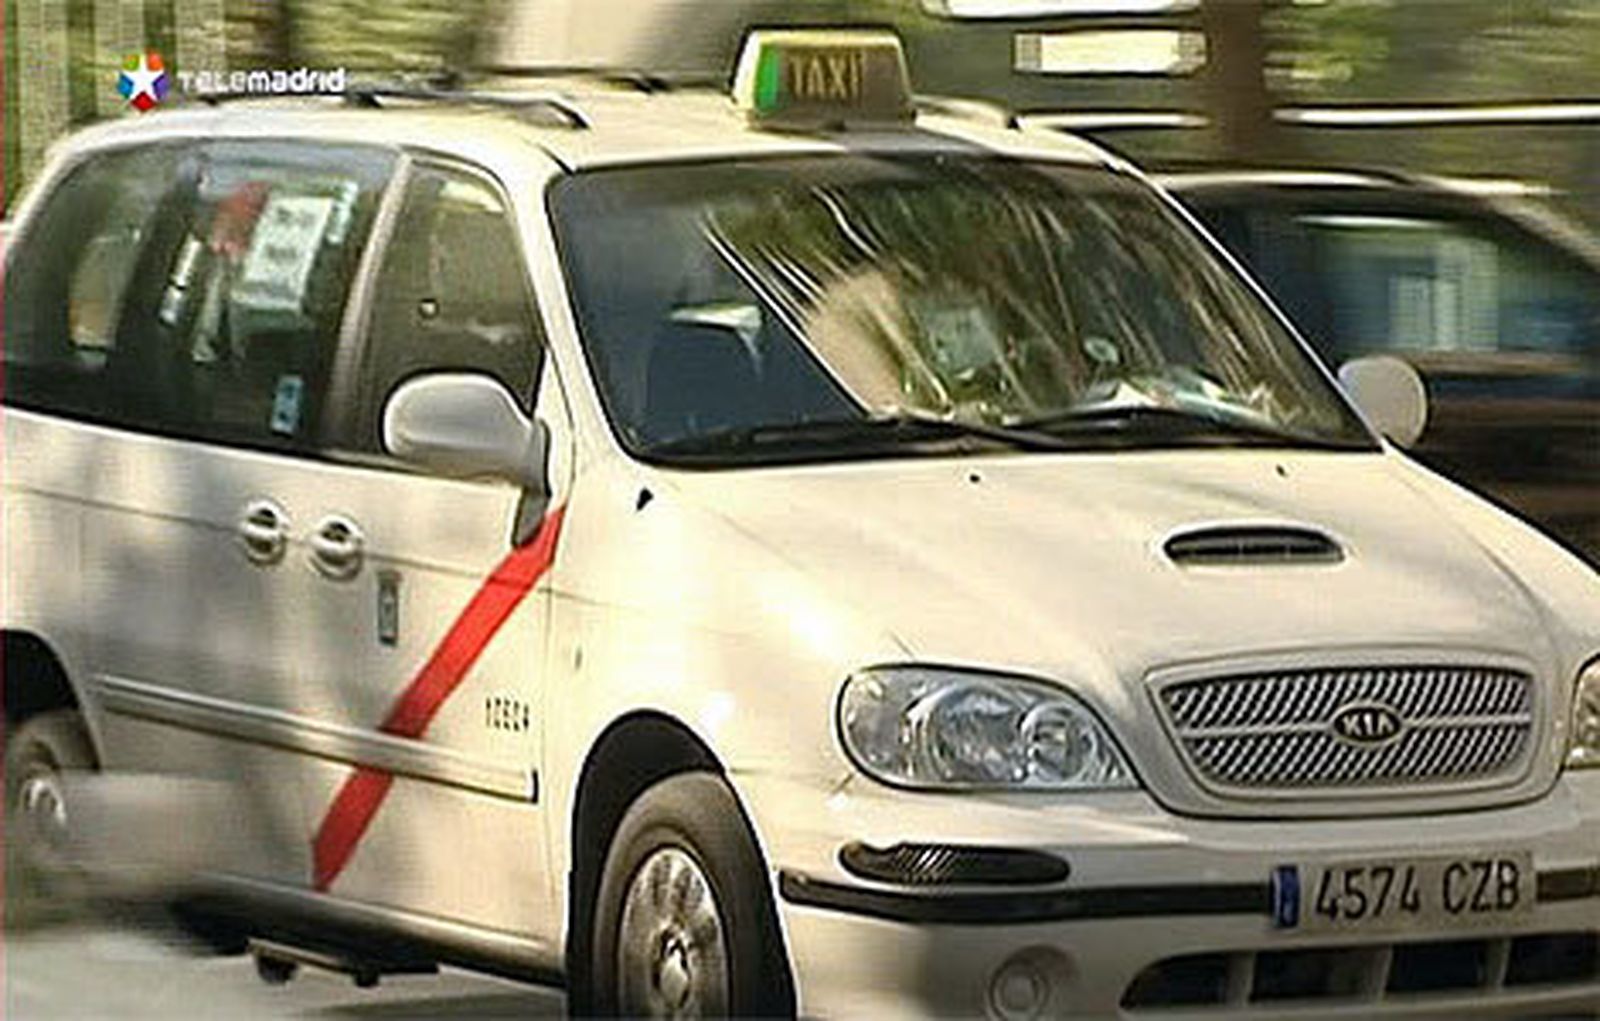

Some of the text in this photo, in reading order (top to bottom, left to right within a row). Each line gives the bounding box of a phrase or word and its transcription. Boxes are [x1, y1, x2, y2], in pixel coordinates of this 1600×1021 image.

[788, 53, 862, 99] TAXI
[1342, 711, 1395, 736] KIA
[1315, 859, 1520, 920] 4574 CZB
